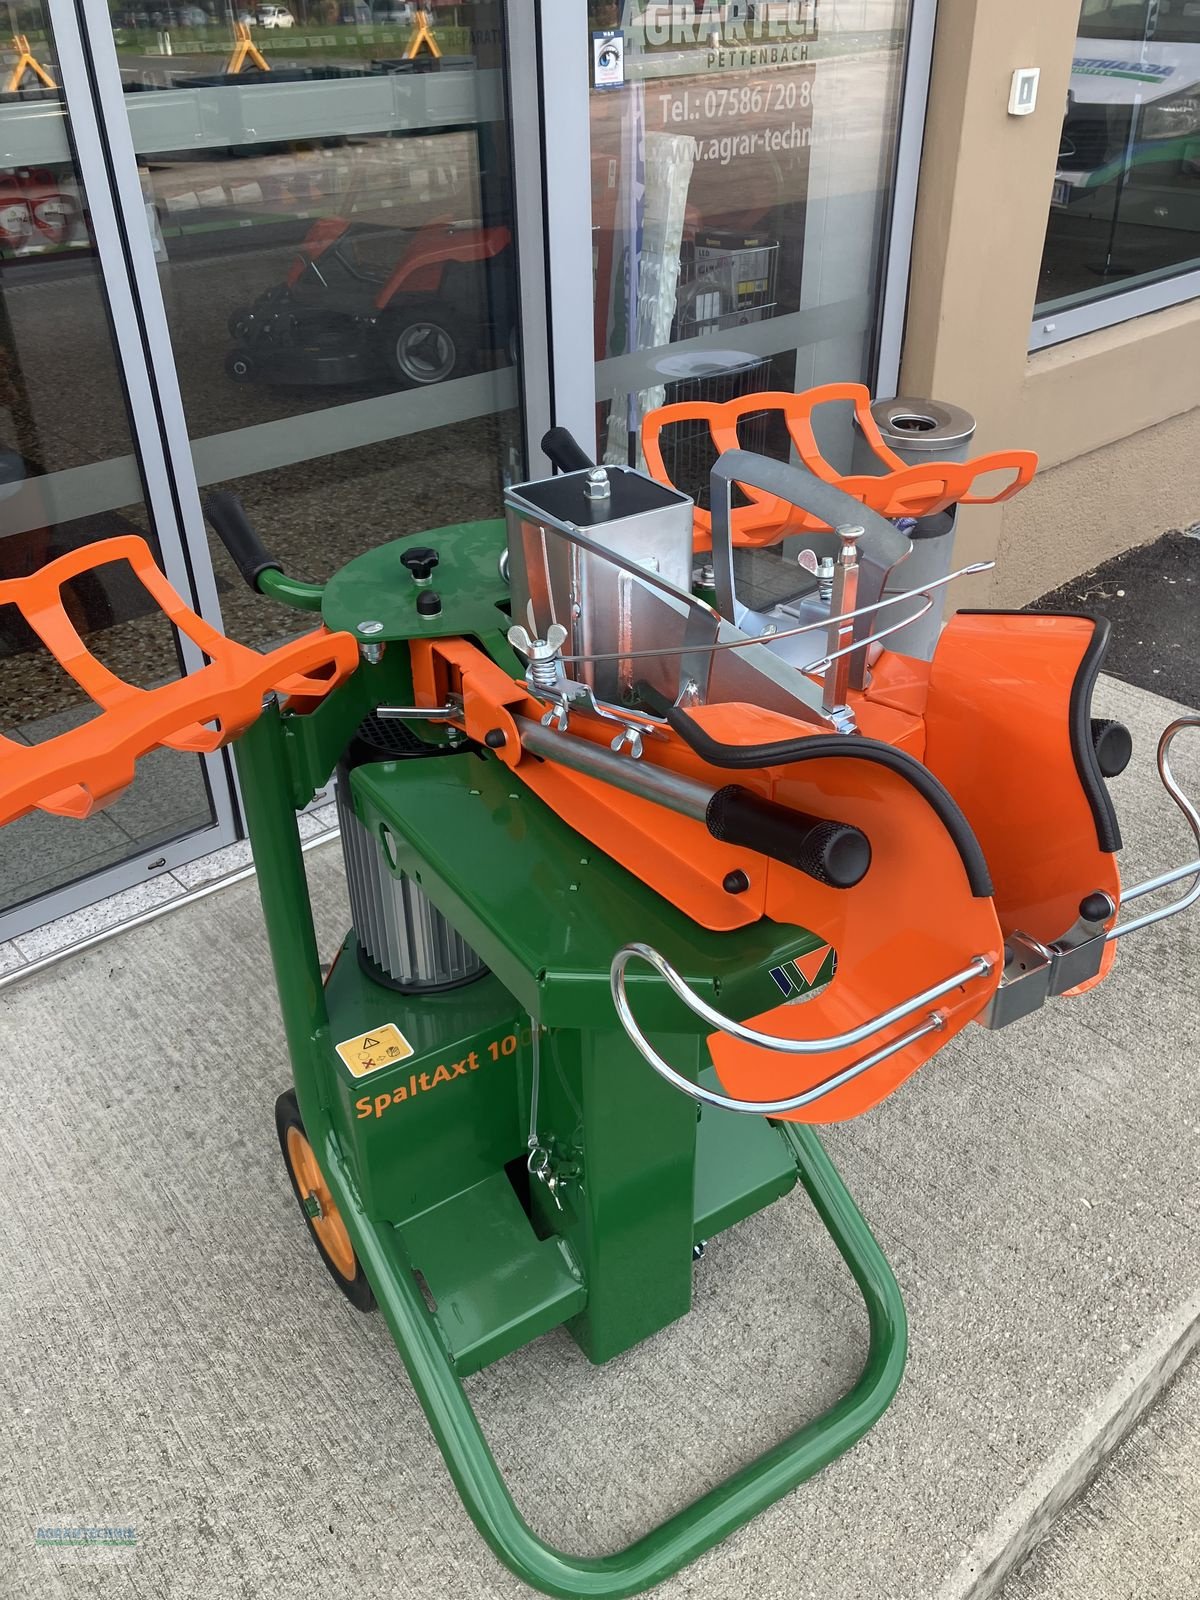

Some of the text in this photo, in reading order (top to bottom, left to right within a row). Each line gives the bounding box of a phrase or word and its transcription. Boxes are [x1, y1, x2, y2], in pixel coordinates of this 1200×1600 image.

[707, 45, 809, 69] PETTENBACH
[659, 91, 700, 123] Tel.:
[355, 1050, 480, 1119] SpaltAxt
